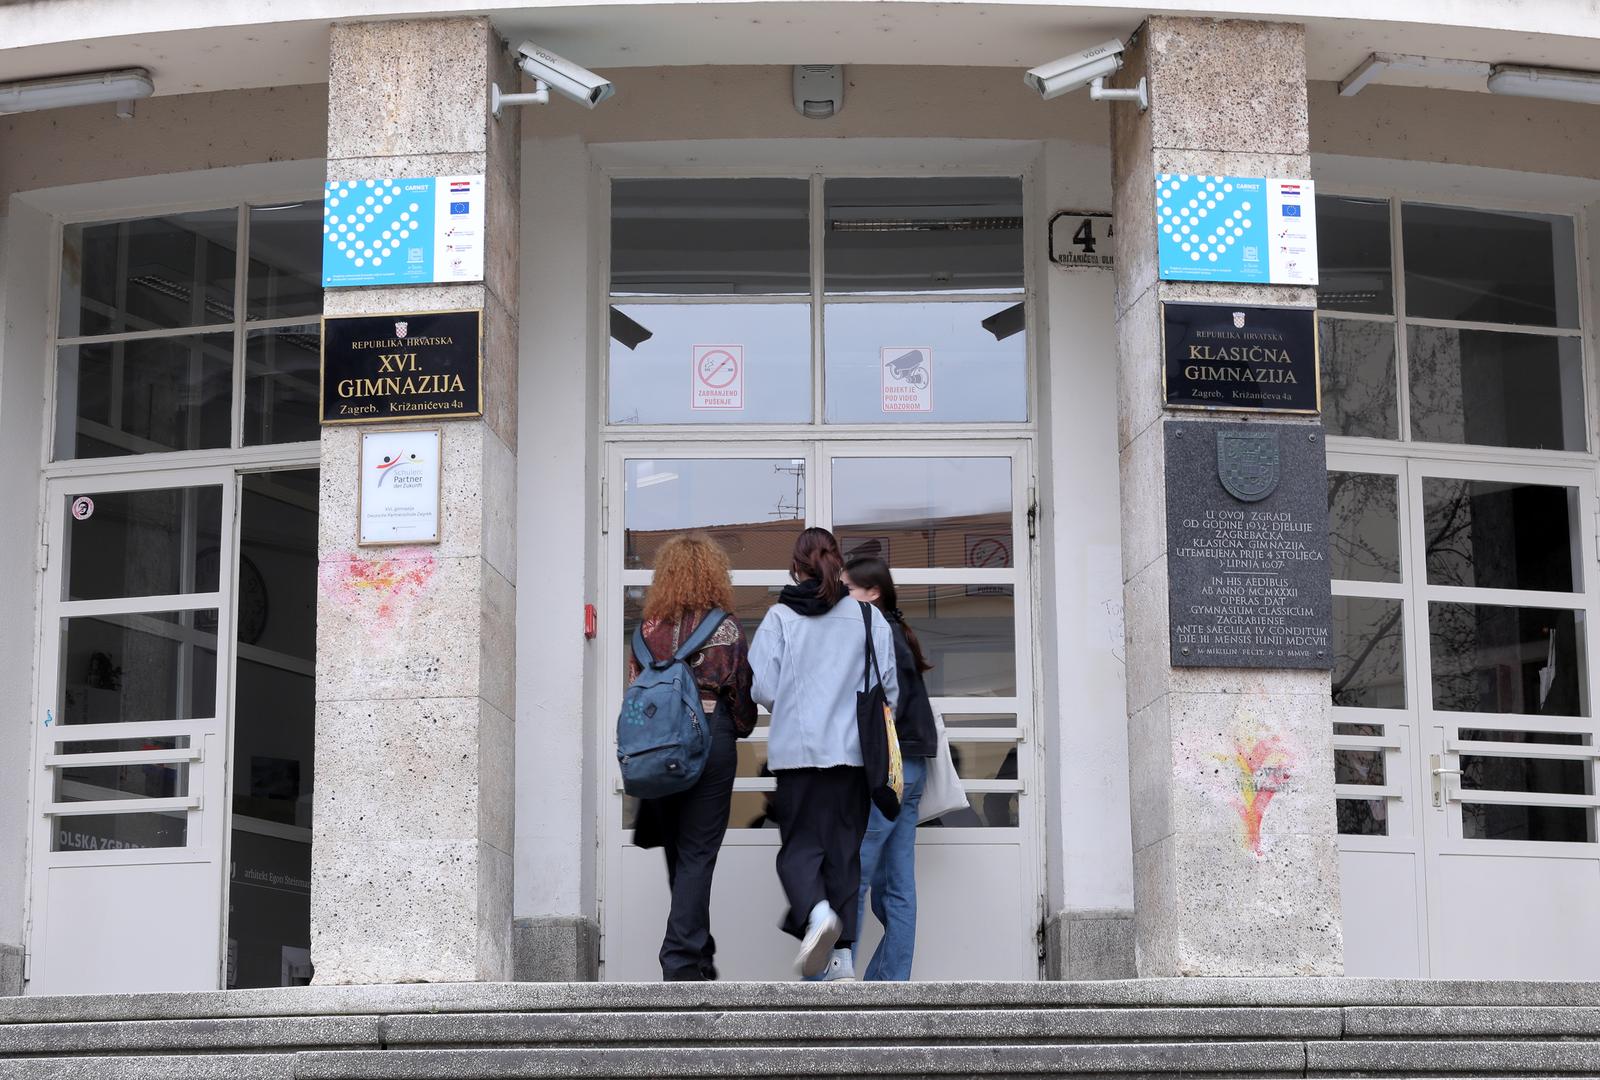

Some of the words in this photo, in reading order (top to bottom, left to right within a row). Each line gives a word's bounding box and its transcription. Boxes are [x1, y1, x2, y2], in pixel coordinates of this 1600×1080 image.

[1073, 218, 1096, 253] 4
[1101, 256, 1113, 264] ULI
[1196, 330, 1241, 340] REPUBLIKA
[1243, 332, 1283, 342] HRVATSKA
[352, 339, 403, 350] REPUBLIKA
[406, 336, 453, 347] HRVATSKA
[1188, 345, 1292, 364] KLASIČNA
[378, 353, 423, 373] XVI.
[1184, 365, 1298, 384] GIMNAZIJA
[337, 374, 466, 398] GIMNAZIJA
[899, 394, 918, 402] VIDEO
[1191, 388, 1224, 399] Zagreb,
[1232, 390, 1281, 400] Križanićeva
[1281, 392, 1292, 401] 4a
[390, 401, 450, 412] Križanićeva
[451, 399, 464, 409] 4a
[704, 397, 732, 405] PUŠENJE
[1206, 511, 1214, 519] U
[1218, 511, 1244, 520] OVOJ
[1251, 512, 1291, 522] ZGRADI
[1183, 519, 1199, 528] OD
[1202, 519, 1243, 530] GODINE
[1272, 523, 1313, 533] DJELUJE
[1215, 529, 1284, 540] ZAGREBAČKA
[1193, 538, 1244, 549] KLASIČNA
[1248, 540, 1305, 551] GIMNAZIJA
[1176, 548, 1237, 559] UTEMELJENA
[1239, 550, 1264, 560] PRIJE
[1266, 550, 1273, 559] 4
[1275, 550, 1324, 561] STOLJEĆA
[1226, 559, 1260, 569] LIPNJA
[1212, 577, 1223, 586] IN
[1226, 578, 1242, 586] HIS
[1245, 578, 1289, 587] AEDIBUS
[1201, 587, 1213, 595] AB
[1216, 587, 1245, 596] ANNO
[1248, 588, 1298, 597] MCMXXXII
[1220, 596, 1260, 606] OPERAS
[1264, 597, 1286, 606] DAT
[1190, 605, 1253, 615] GYMNASIUM
[1258, 607, 1314, 617] CLASSICUM
[1216, 615, 1285, 625] ZAGRABIENSE
[1176, 625, 1203, 634] ANTE
[1206, 625, 1252, 635] SAECULA
[1255, 626, 1266, 635] IV
[1269, 626, 1329, 636] CONDITUM
[1178, 634, 1196, 643] DIE
[1199, 635, 1210, 643] III
[1214, 635, 1251, 644] MENSIS
[1255, 635, 1282, 645] IUNII
[1286, 636, 1327, 646] MDCVII
[269, 872, 284, 885] Egon
